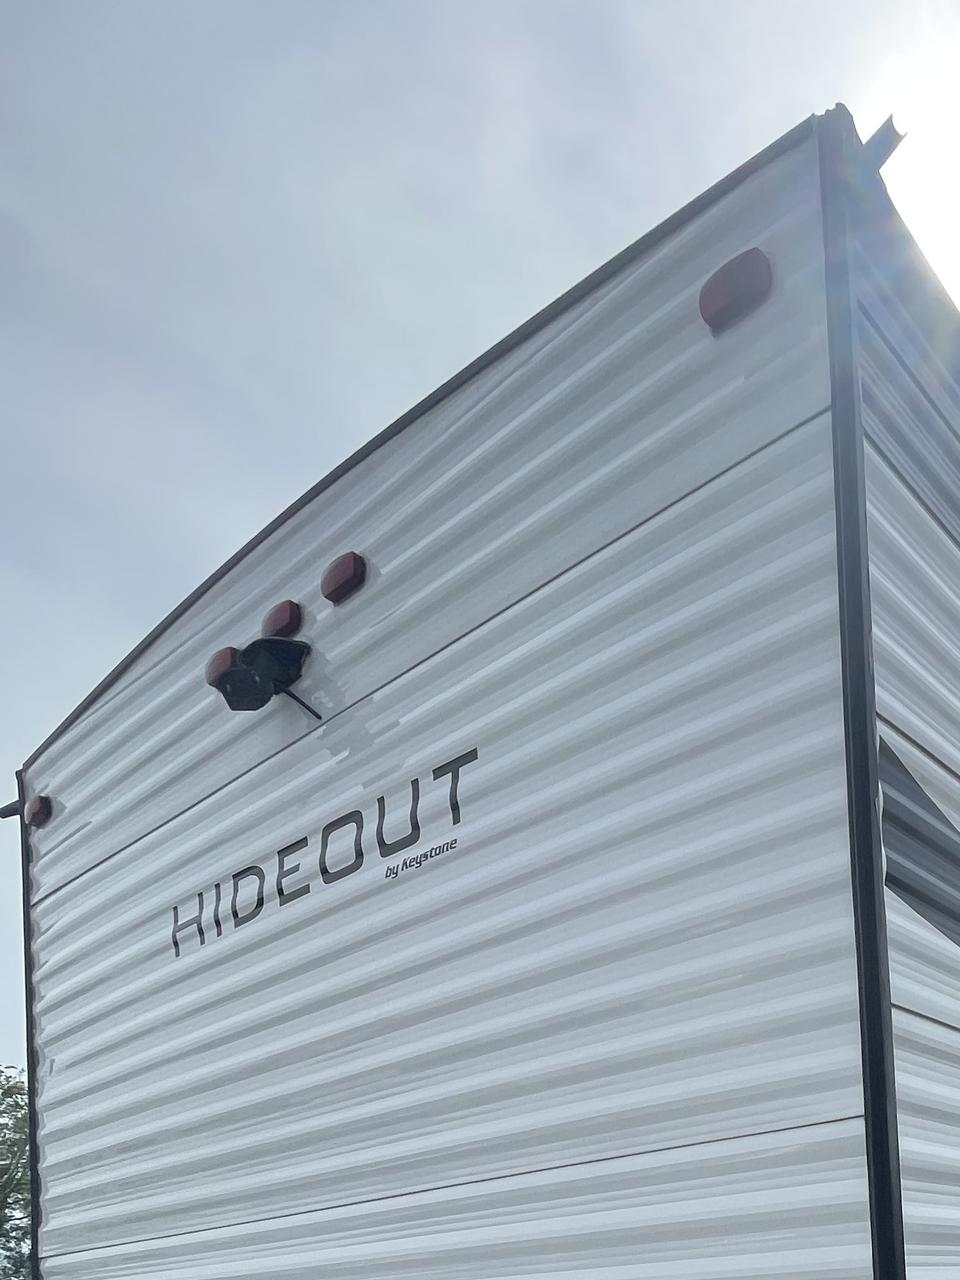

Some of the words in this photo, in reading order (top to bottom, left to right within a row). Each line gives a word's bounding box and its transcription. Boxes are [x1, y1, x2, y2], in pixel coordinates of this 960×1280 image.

[171, 747, 479, 958] HIDEOUT
[385, 864, 400, 879] by
[401, 838, 458, 871] Keystone
